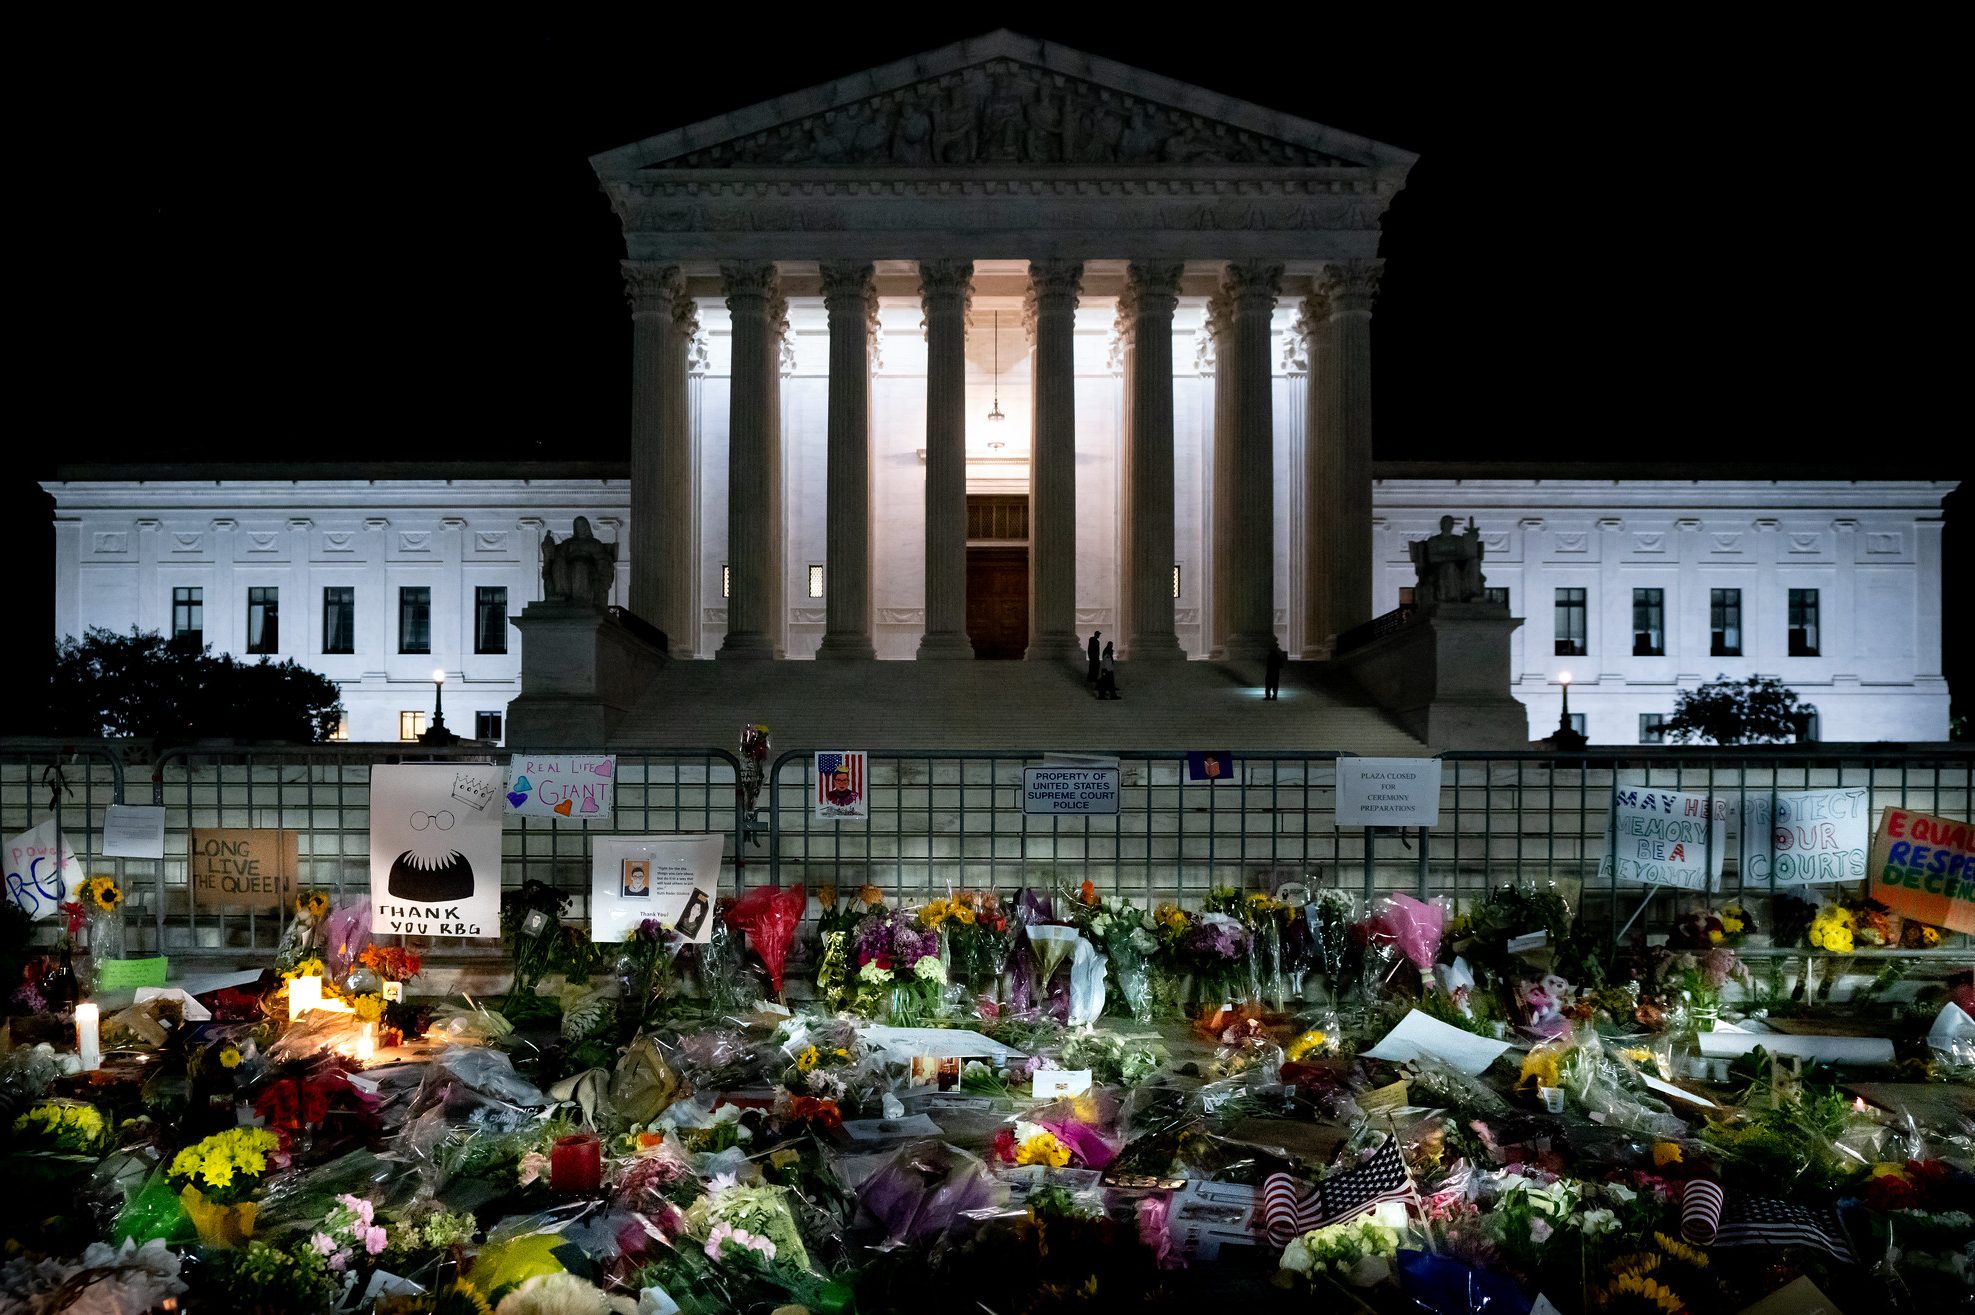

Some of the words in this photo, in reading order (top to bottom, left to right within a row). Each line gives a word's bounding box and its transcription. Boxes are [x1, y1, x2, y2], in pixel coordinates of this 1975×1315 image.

[526, 761, 561, 774] REAL
[571, 760, 596, 774] LIFE
[1035, 772, 1089, 781] PROPERTY
[1092, 772, 1107, 781] OF
[1360, 772, 1386, 780] PLAZA
[1386, 772, 1417, 780] CLOSED
[538, 779, 609, 806] GIANT
[1027, 791, 1076, 800] SUPREME
[1080, 791, 1115, 800] COURT
[1032, 782, 1069, 790] UNITED
[1073, 782, 1110, 790] STATES
[1053, 801, 1090, 809] POLICE
[1616, 790, 1677, 814] MAY
[1684, 798, 1727, 821] HER
[1738, 790, 1866, 825] PROTECT
[1608, 815, 1710, 845] MEMORY
[1773, 822, 1839, 851] OUR
[192, 837, 250, 857] LONG
[1637, 838, 1666, 862] BE
[1669, 843, 1685, 863] A
[208, 857, 261, 876] LIVE
[1748, 848, 1866, 881] COURTS
[192, 874, 217, 890] THE
[221, 875, 290, 894] QUEEN
[379, 905, 461, 920] THANK
[390, 921, 428, 935] YOU
[440, 923, 481, 935] RBG
